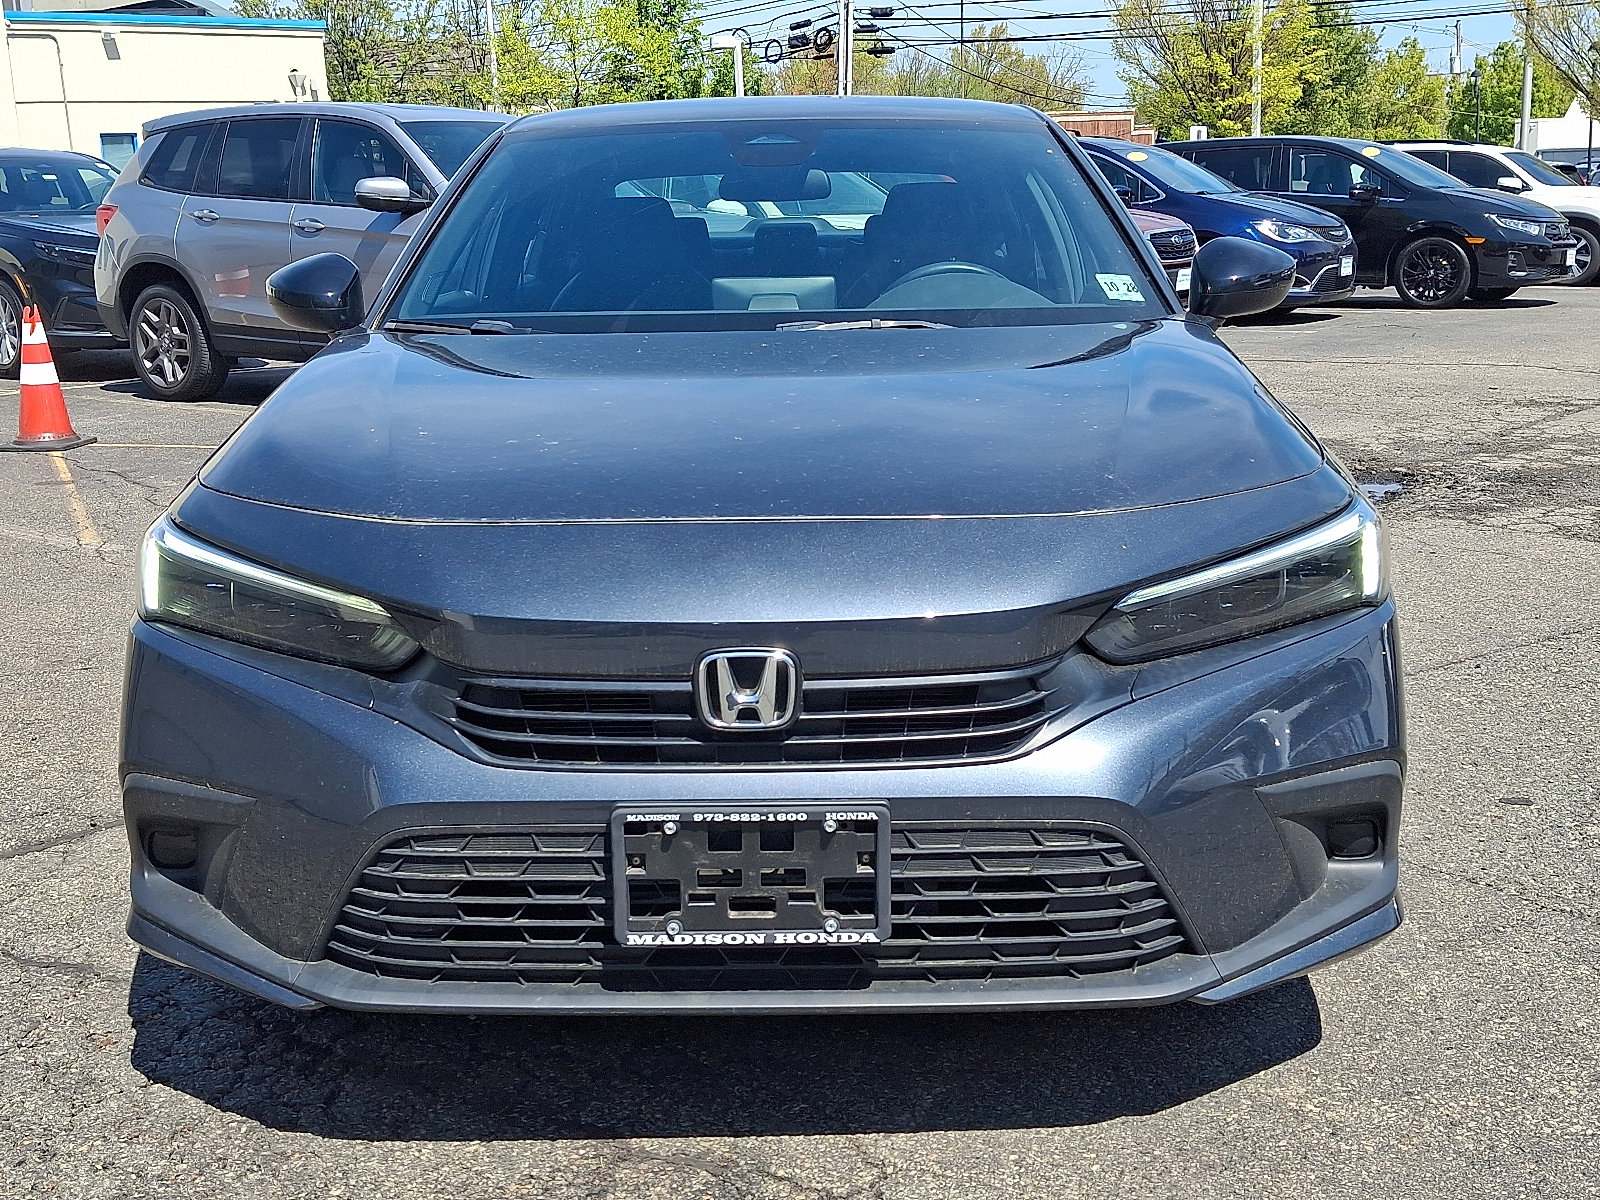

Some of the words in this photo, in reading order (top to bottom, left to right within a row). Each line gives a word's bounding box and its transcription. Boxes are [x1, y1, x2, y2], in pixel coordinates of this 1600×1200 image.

[1104, 281, 1120, 292] 10
[626, 813, 681, 822] MADISON
[693, 812, 808, 822] 973-822-1600
[825, 811, 879, 821] HONDA
[626, 932, 767, 946] MADISON
[773, 931, 881, 944] HONDA
